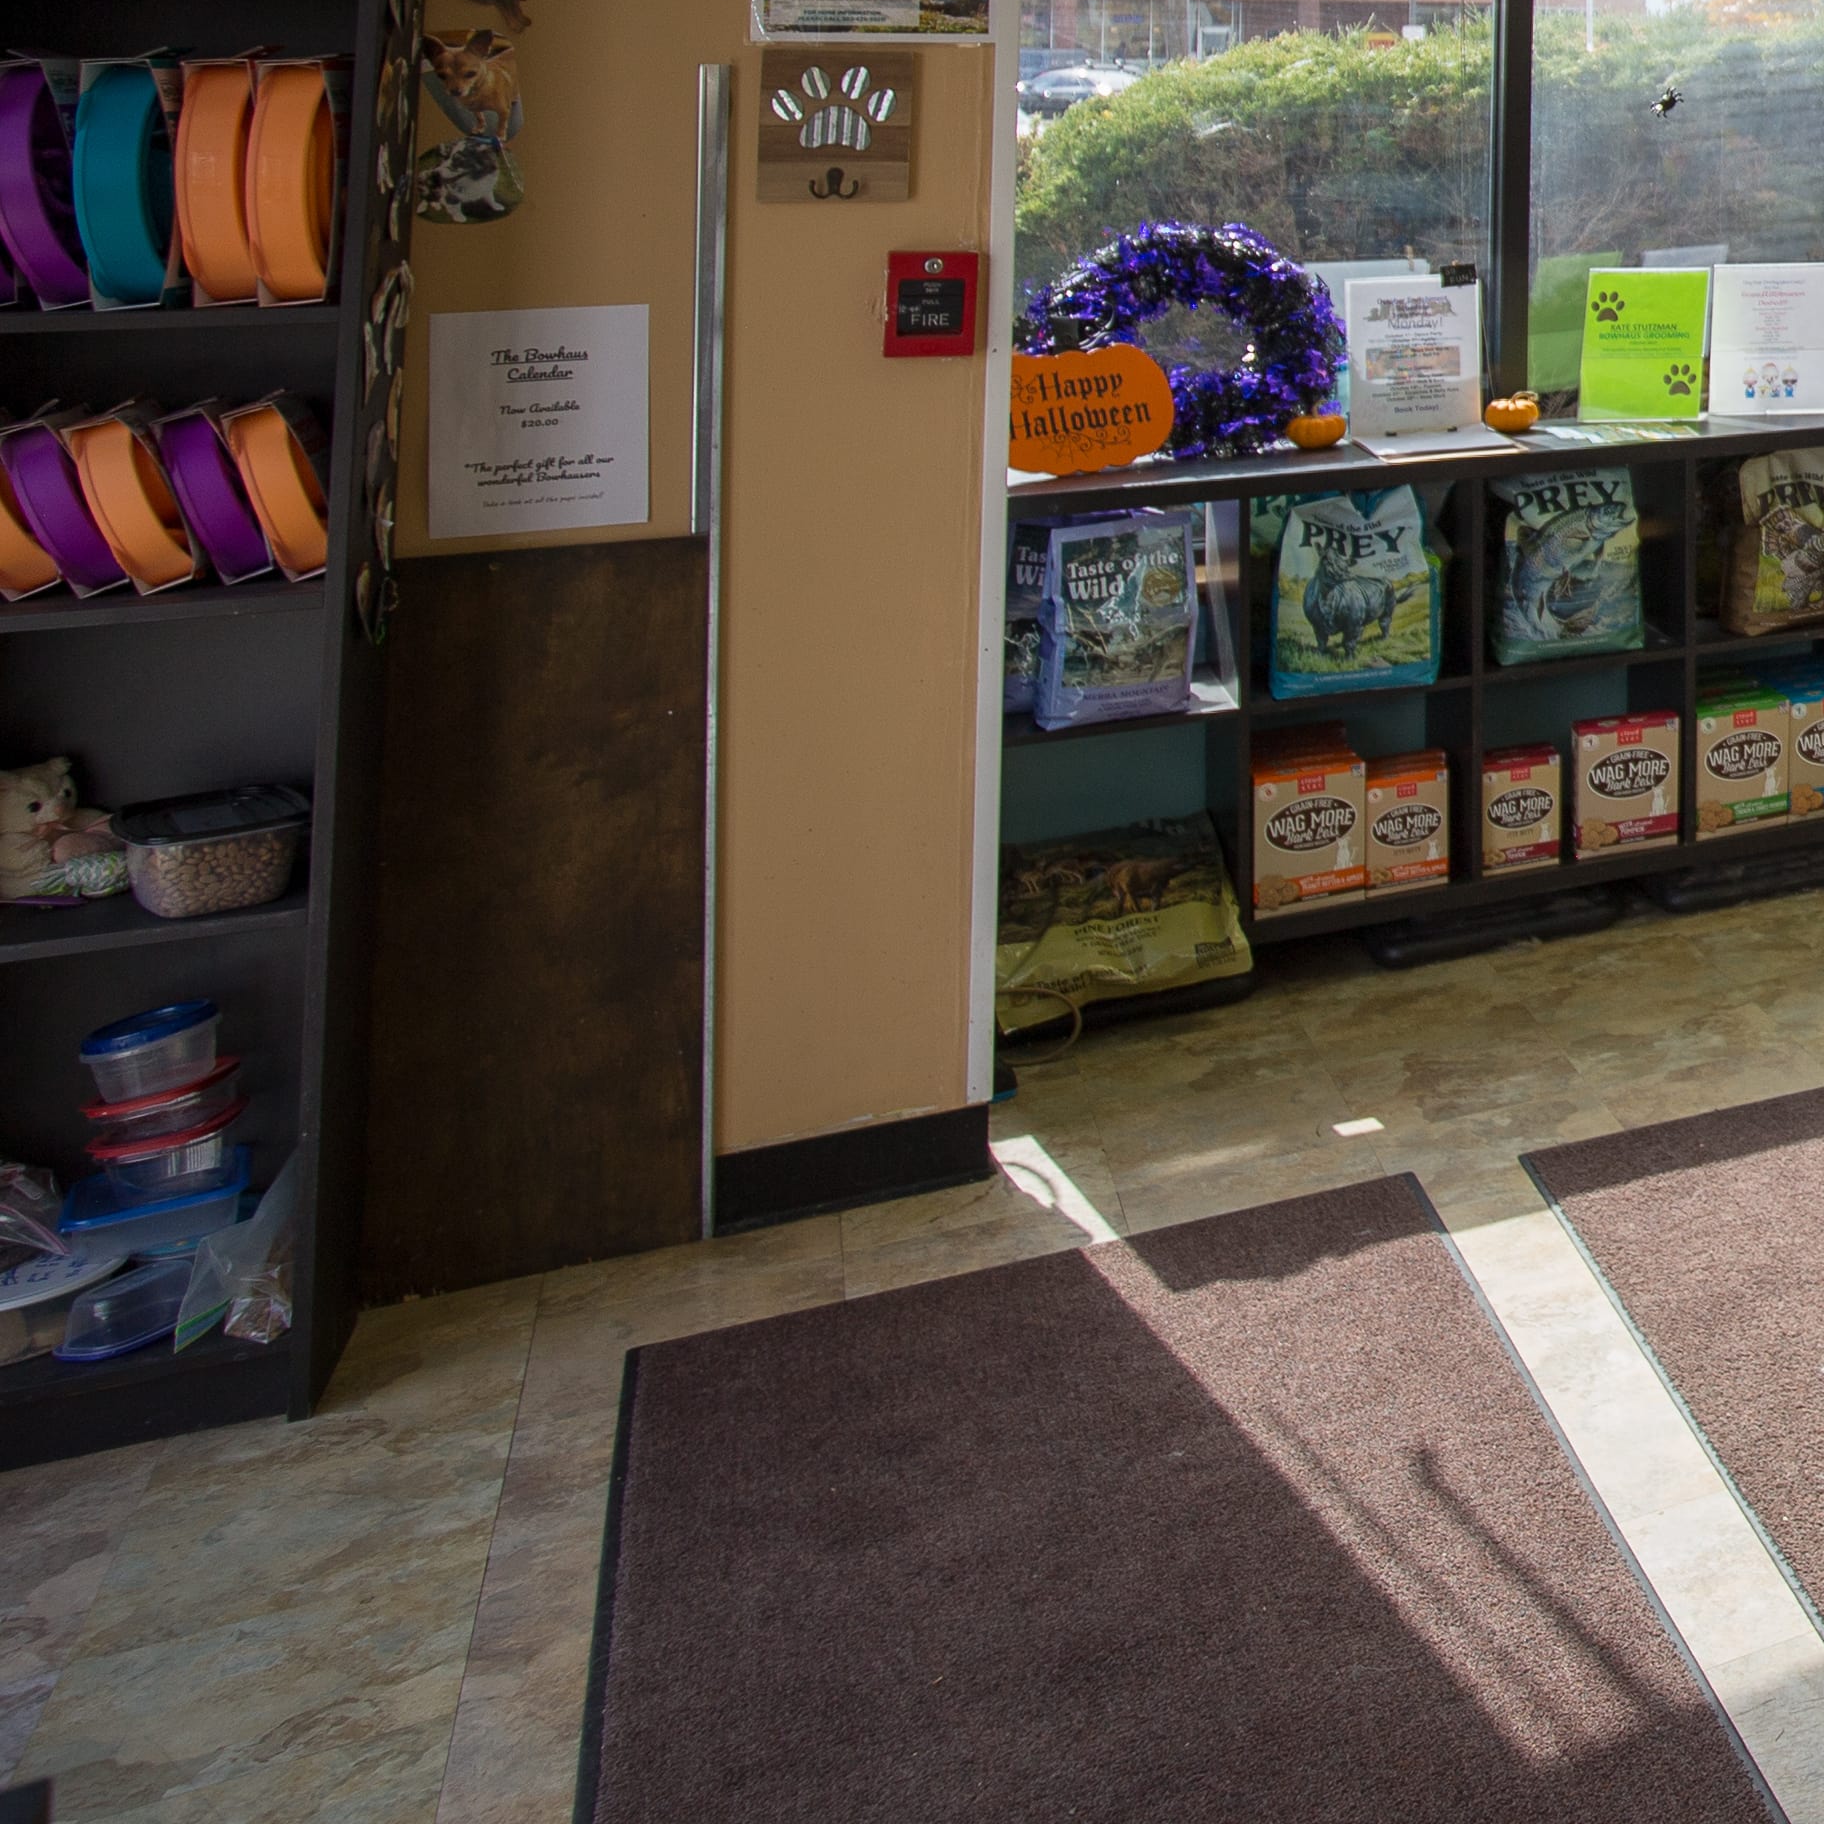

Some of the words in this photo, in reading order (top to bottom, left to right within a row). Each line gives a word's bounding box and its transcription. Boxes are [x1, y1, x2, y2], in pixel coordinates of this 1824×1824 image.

[911, 313, 950, 326] FIRE
[1387, 317, 1443, 330] Monday!
[1633, 323, 1677, 331] STUTZMAN
[1643, 331, 1690, 339] GROOMING
[491, 349, 520, 364] The
[524, 346, 589, 363] Bowhaus
[507, 364, 573, 381] Calendar
[1037, 371, 1124, 401] Happy
[500, 405, 527, 415] Now
[529, 400, 580, 414] Available
[521, 418, 559, 428] $20.00
[1009, 402, 1152, 440] Halloween
[494, 459, 534, 474] perfect
[535, 456, 556, 472] gift
[558, 456, 575, 469] for
[578, 454, 594, 466] all
[596, 456, 615, 465] our
[477, 473, 533, 487] wonderful
[1514, 480, 1620, 520] PREY
[1299, 520, 1406, 559] PREY
[1017, 546, 1047, 564] Tas
[1067, 560, 1115, 579] Taste
[1122, 553, 1145, 570] of
[1149, 549, 1179, 567] the
[1067, 574, 1126, 601] Wild
[1726, 732, 1763, 746] GRAIN-FREE
[1610, 749, 1649, 764] GRAIN-FREE
[1707, 747, 1740, 768] WAG
[1743, 741, 1780, 760] MORE
[1590, 763, 1625, 785] WAG
[1628, 759, 1668, 777] MORE
[1488, 799, 1517, 818] WAG
[1519, 794, 1552, 812] MORE
[1266, 813, 1306, 840] WAG
[1310, 807, 1354, 831] MORE
[1373, 817, 1403, 837] WAG
[1406, 812, 1440, 831] MORE
